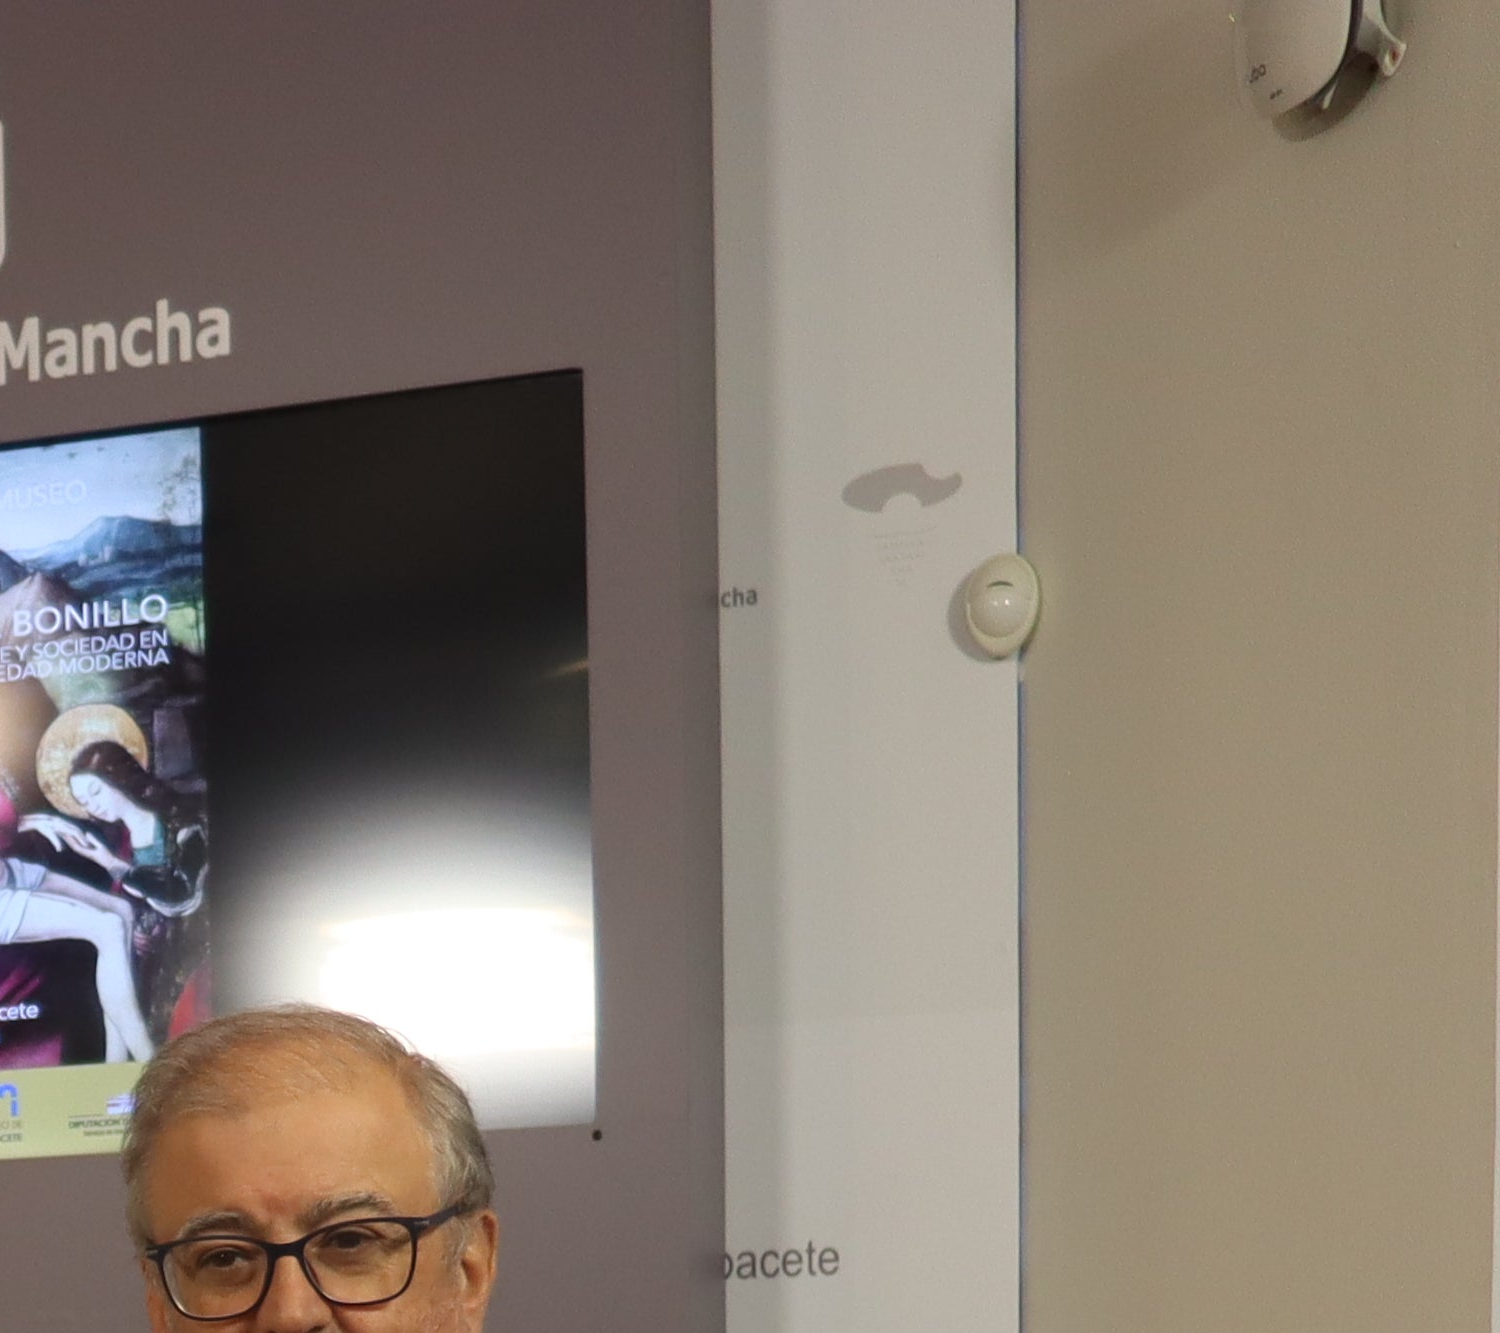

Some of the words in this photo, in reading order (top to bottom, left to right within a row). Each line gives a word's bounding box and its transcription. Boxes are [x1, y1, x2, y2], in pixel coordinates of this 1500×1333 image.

[12, 593, 169, 637] BONILLO
[14, 643, 29, 662] Y
[32, 632, 136, 660] SOCIEDAD
[139, 628, 169, 649] EN
[59, 647, 170, 675] MODERNA
[724, 1240, 841, 1281] acete
